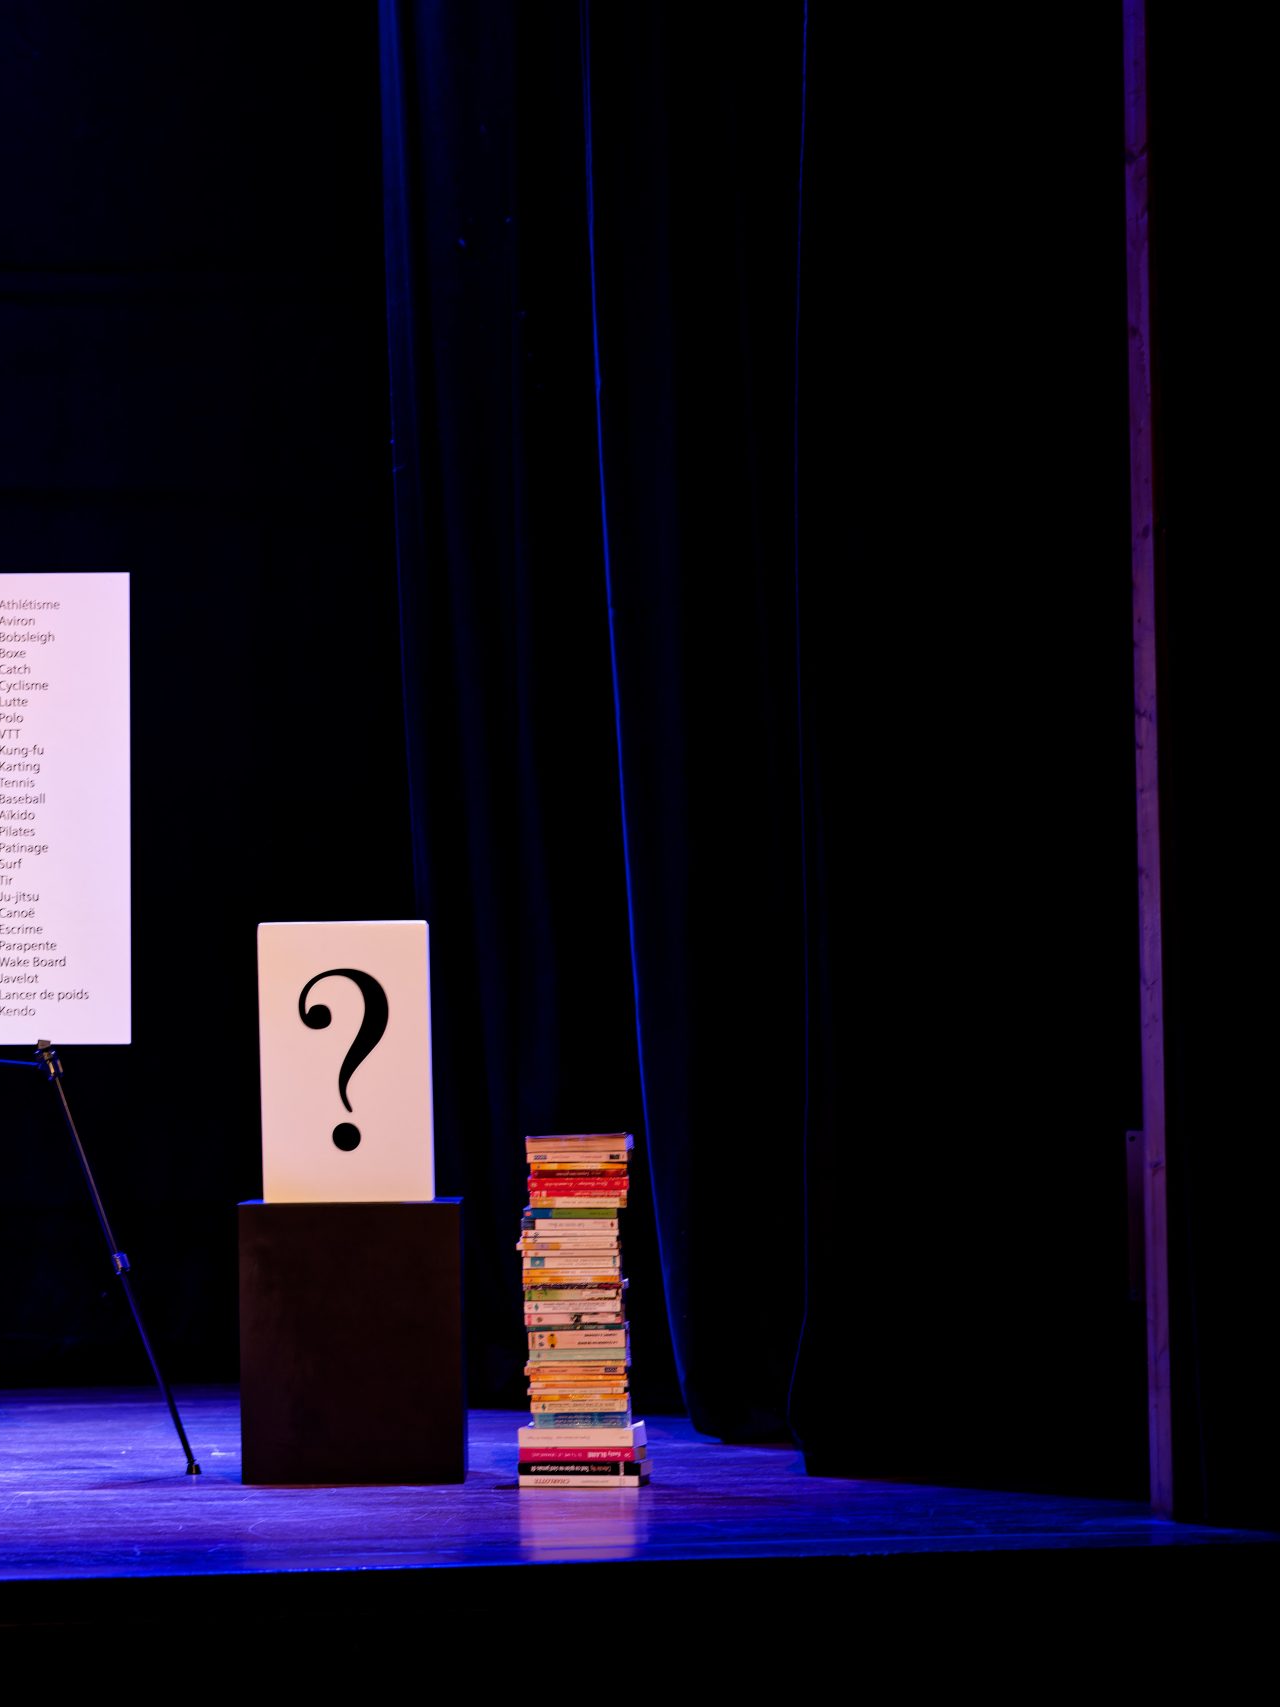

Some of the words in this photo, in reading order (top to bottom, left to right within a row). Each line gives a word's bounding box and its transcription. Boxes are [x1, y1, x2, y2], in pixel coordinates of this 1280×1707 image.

[32, 955, 67, 968] Board
[39, 988, 55, 1001] de
[57, 988, 90, 1003] poids
[298, 968, 390, 1152] ?
